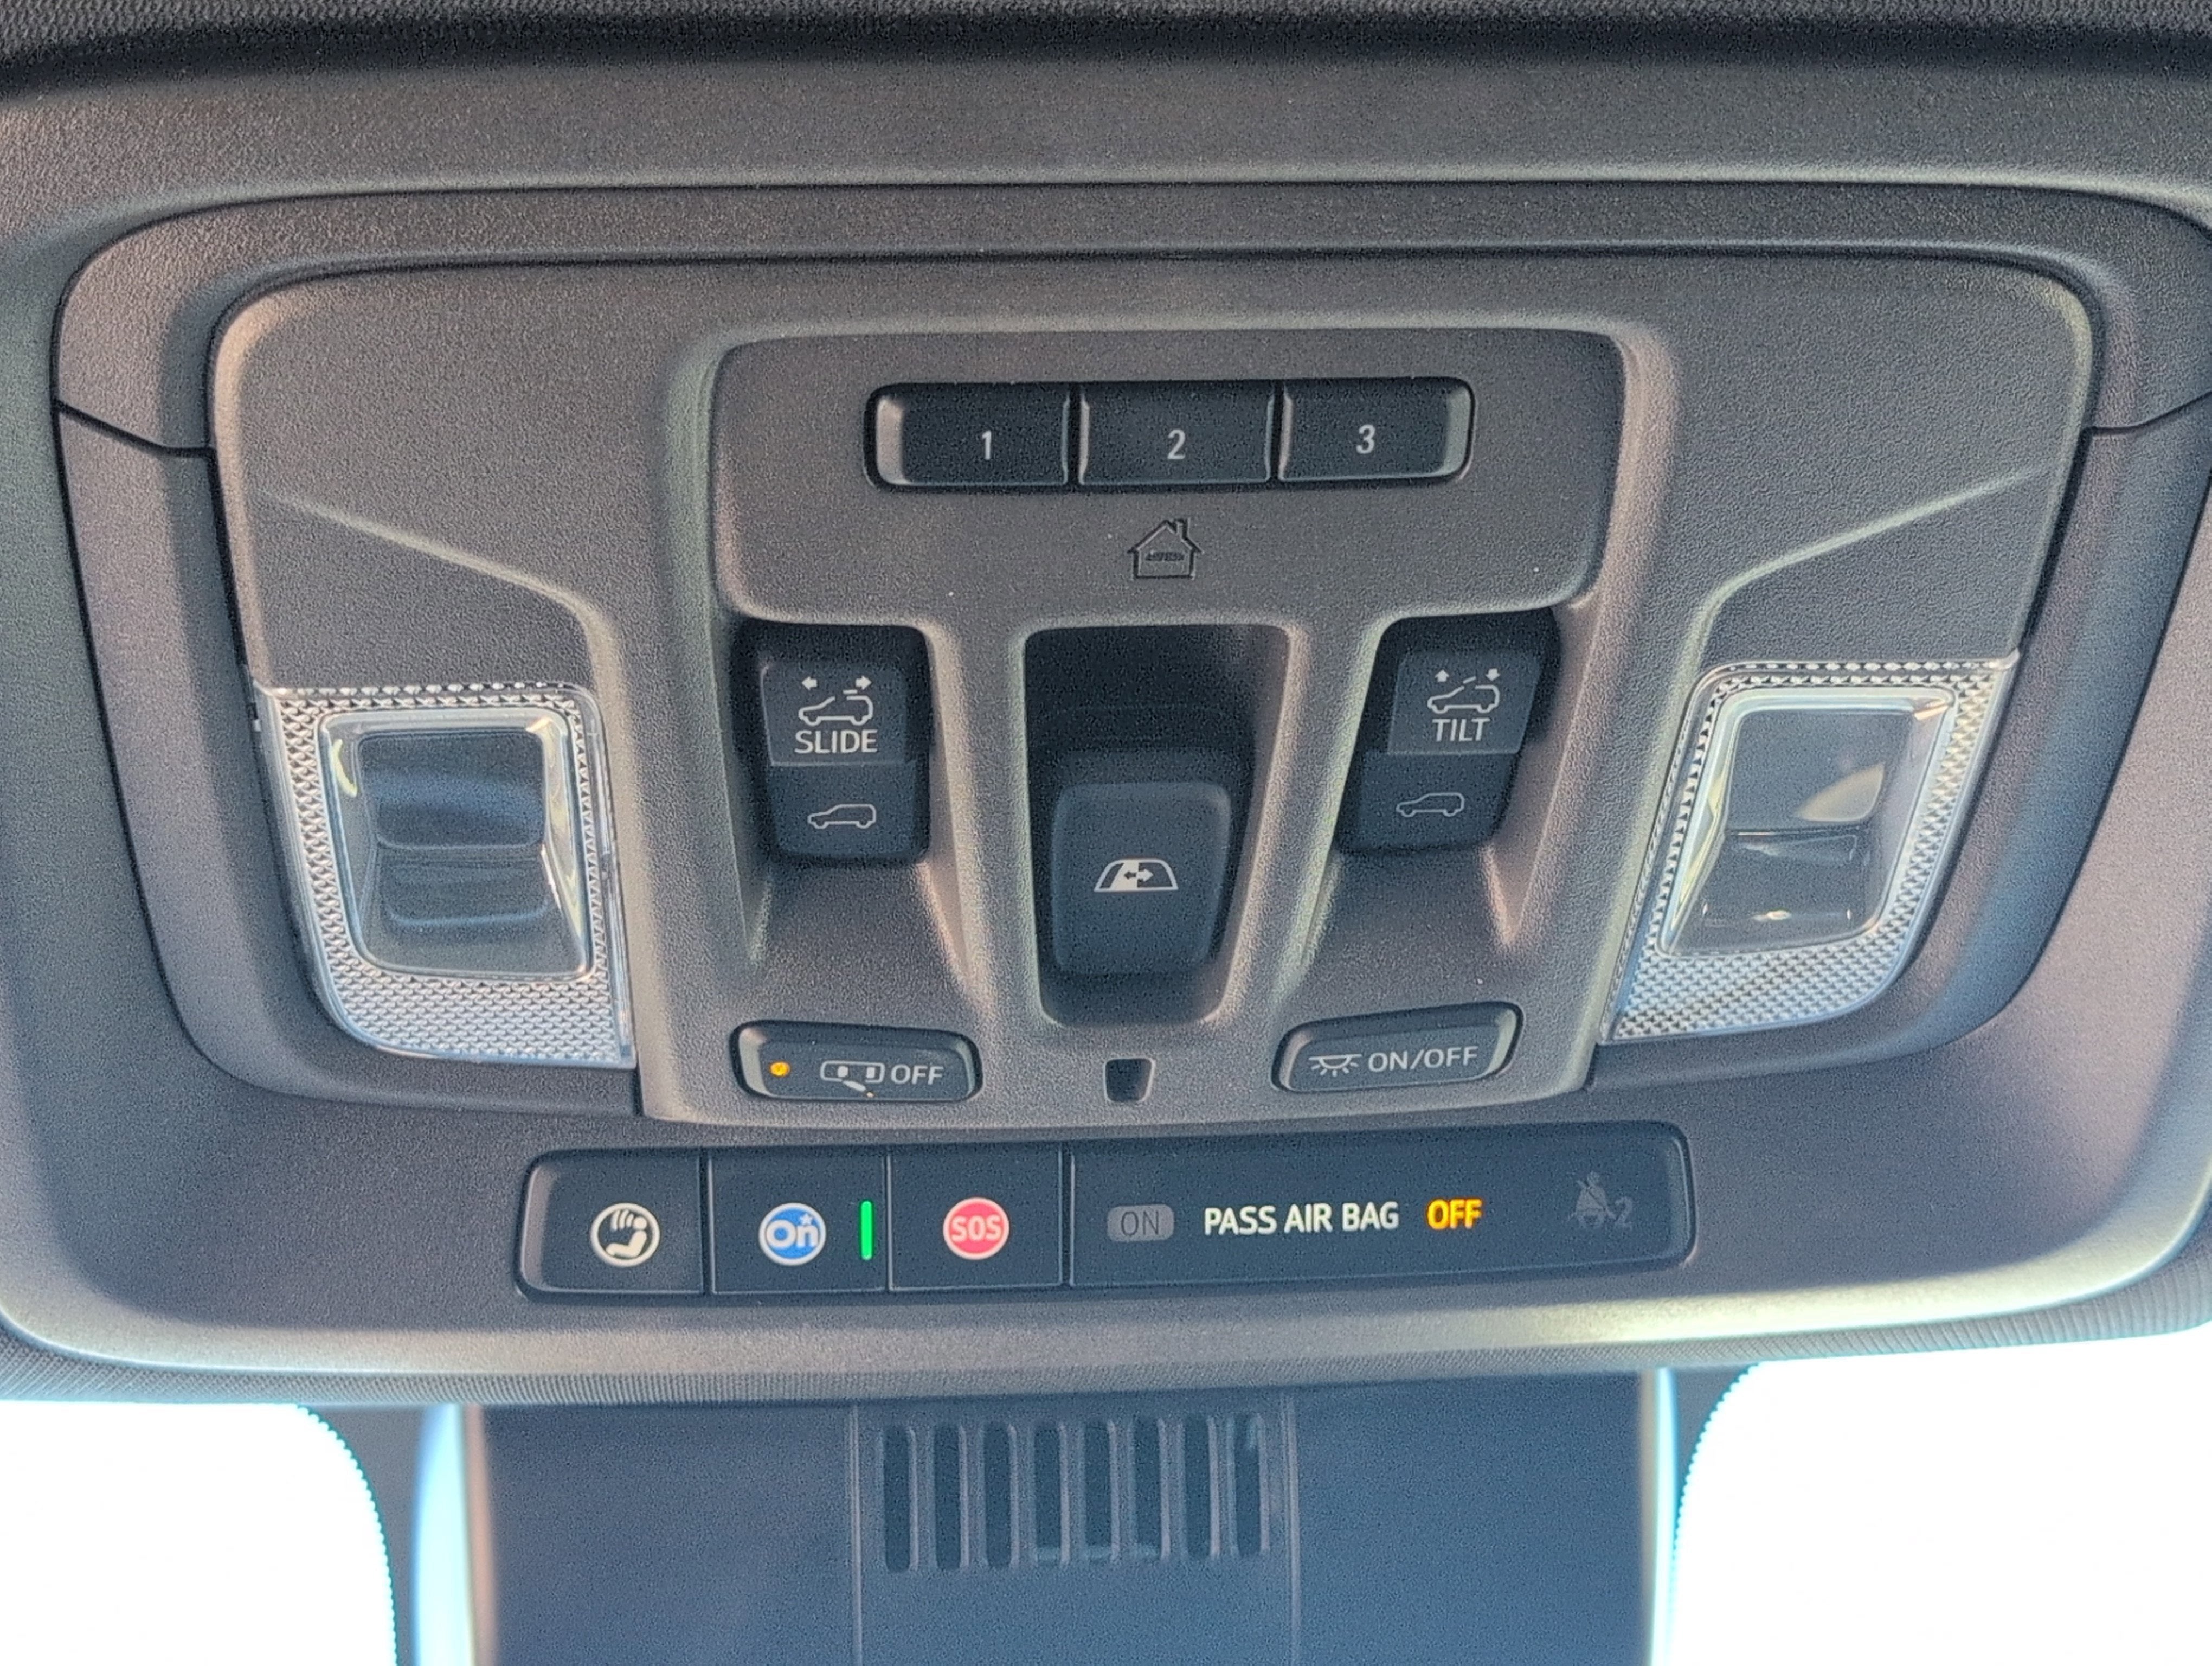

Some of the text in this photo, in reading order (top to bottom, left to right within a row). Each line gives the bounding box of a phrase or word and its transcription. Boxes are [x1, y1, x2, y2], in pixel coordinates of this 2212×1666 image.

[982, 430, 992, 460] 1
[1167, 429, 1186, 460] 2
[1356, 424, 1375, 454] 3
[794, 729, 878, 754] SLIDE
[1432, 717, 1490, 742] TILT
[1368, 1046, 1478, 1072] ON/OFF
[891, 1063, 944, 1085] OFF
[951, 1214, 1002, 1241] SOS
[1121, 1210, 1159, 1236] ON
[1204, 1198, 1483, 1235] PASS AIR BAG OFF
[766, 1219, 819, 1250] On
